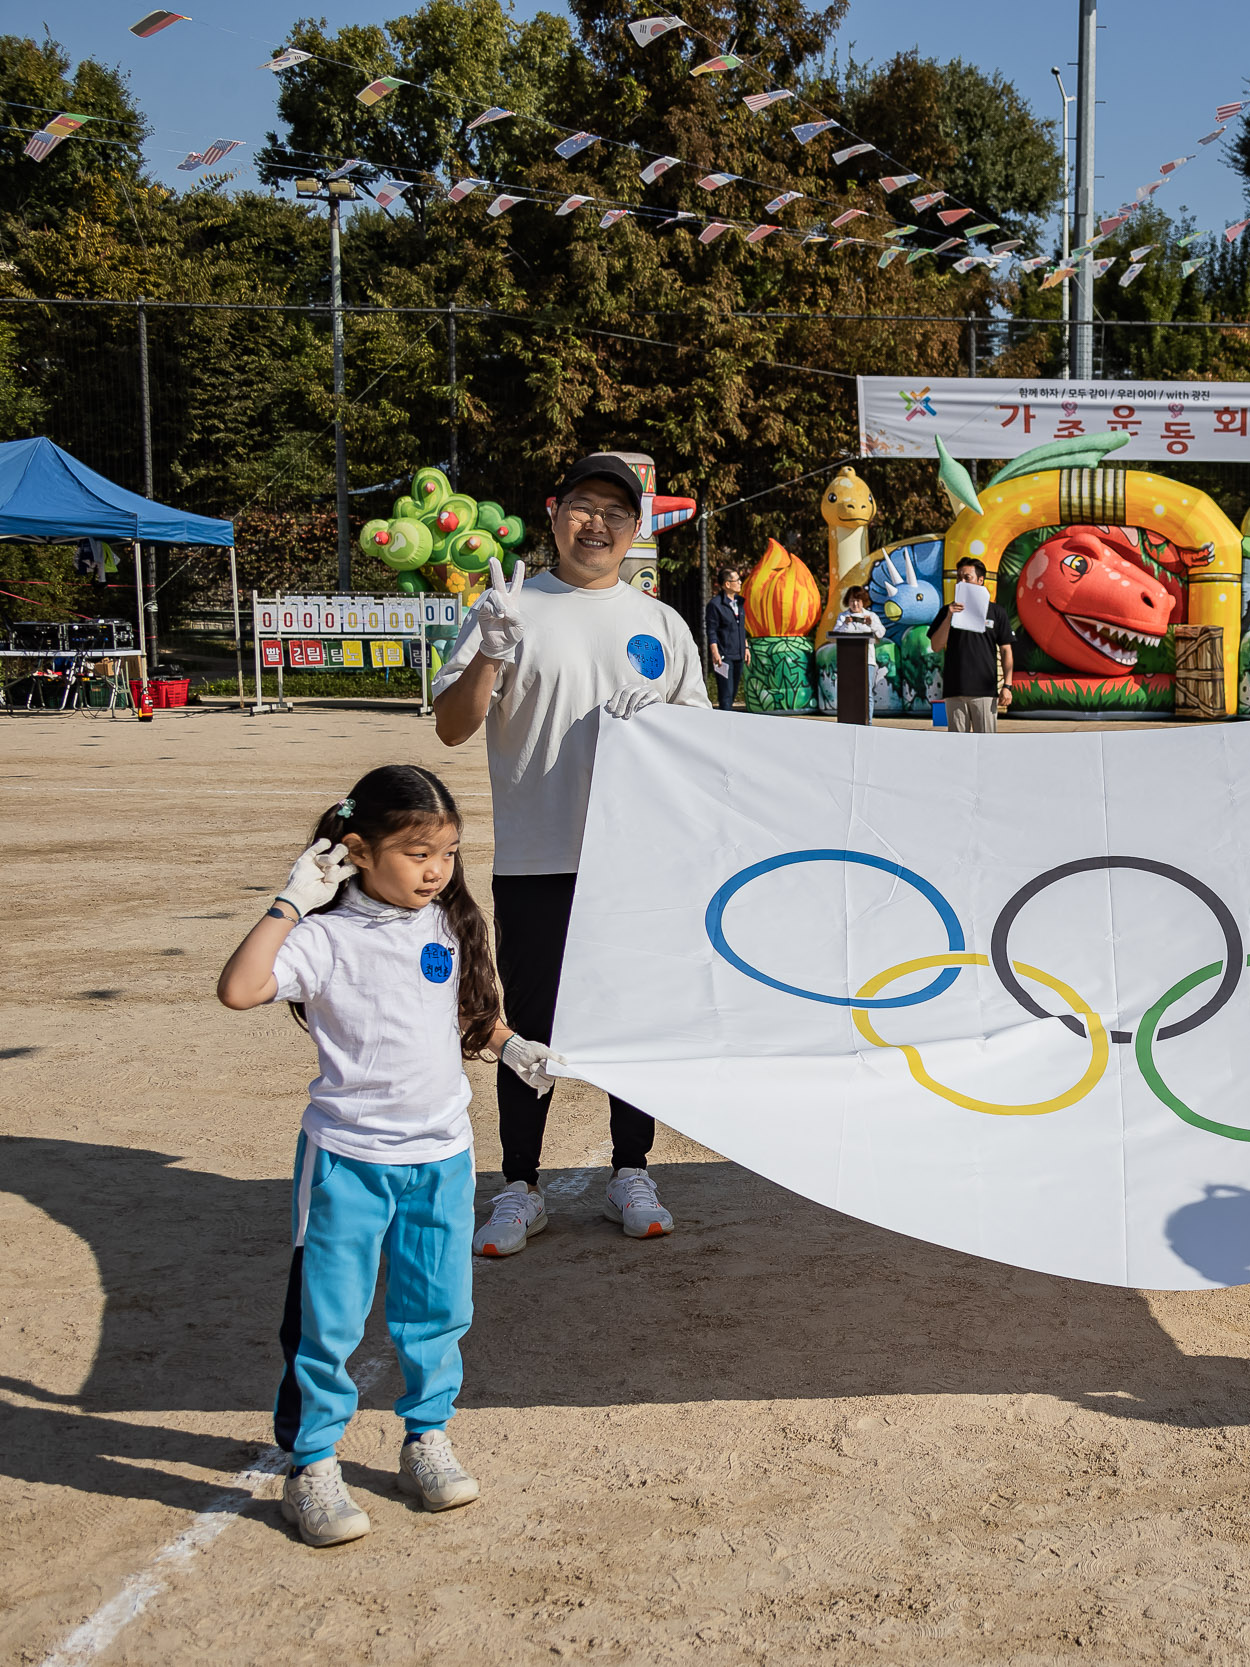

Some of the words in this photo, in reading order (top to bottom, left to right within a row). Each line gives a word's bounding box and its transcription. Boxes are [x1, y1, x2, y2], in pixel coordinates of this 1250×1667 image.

[1019, 388, 1038, 399] 함께
[1039, 388, 1058, 399] 하자
[1068, 389, 1087, 399] 모두
[1090, 389, 1108, 400] 같이
[1117, 389, 1136, 400] 우리
[1137, 390, 1157, 400] 아이
[1166, 390, 1189, 400] with
[1191, 390, 1210, 401] 광진
